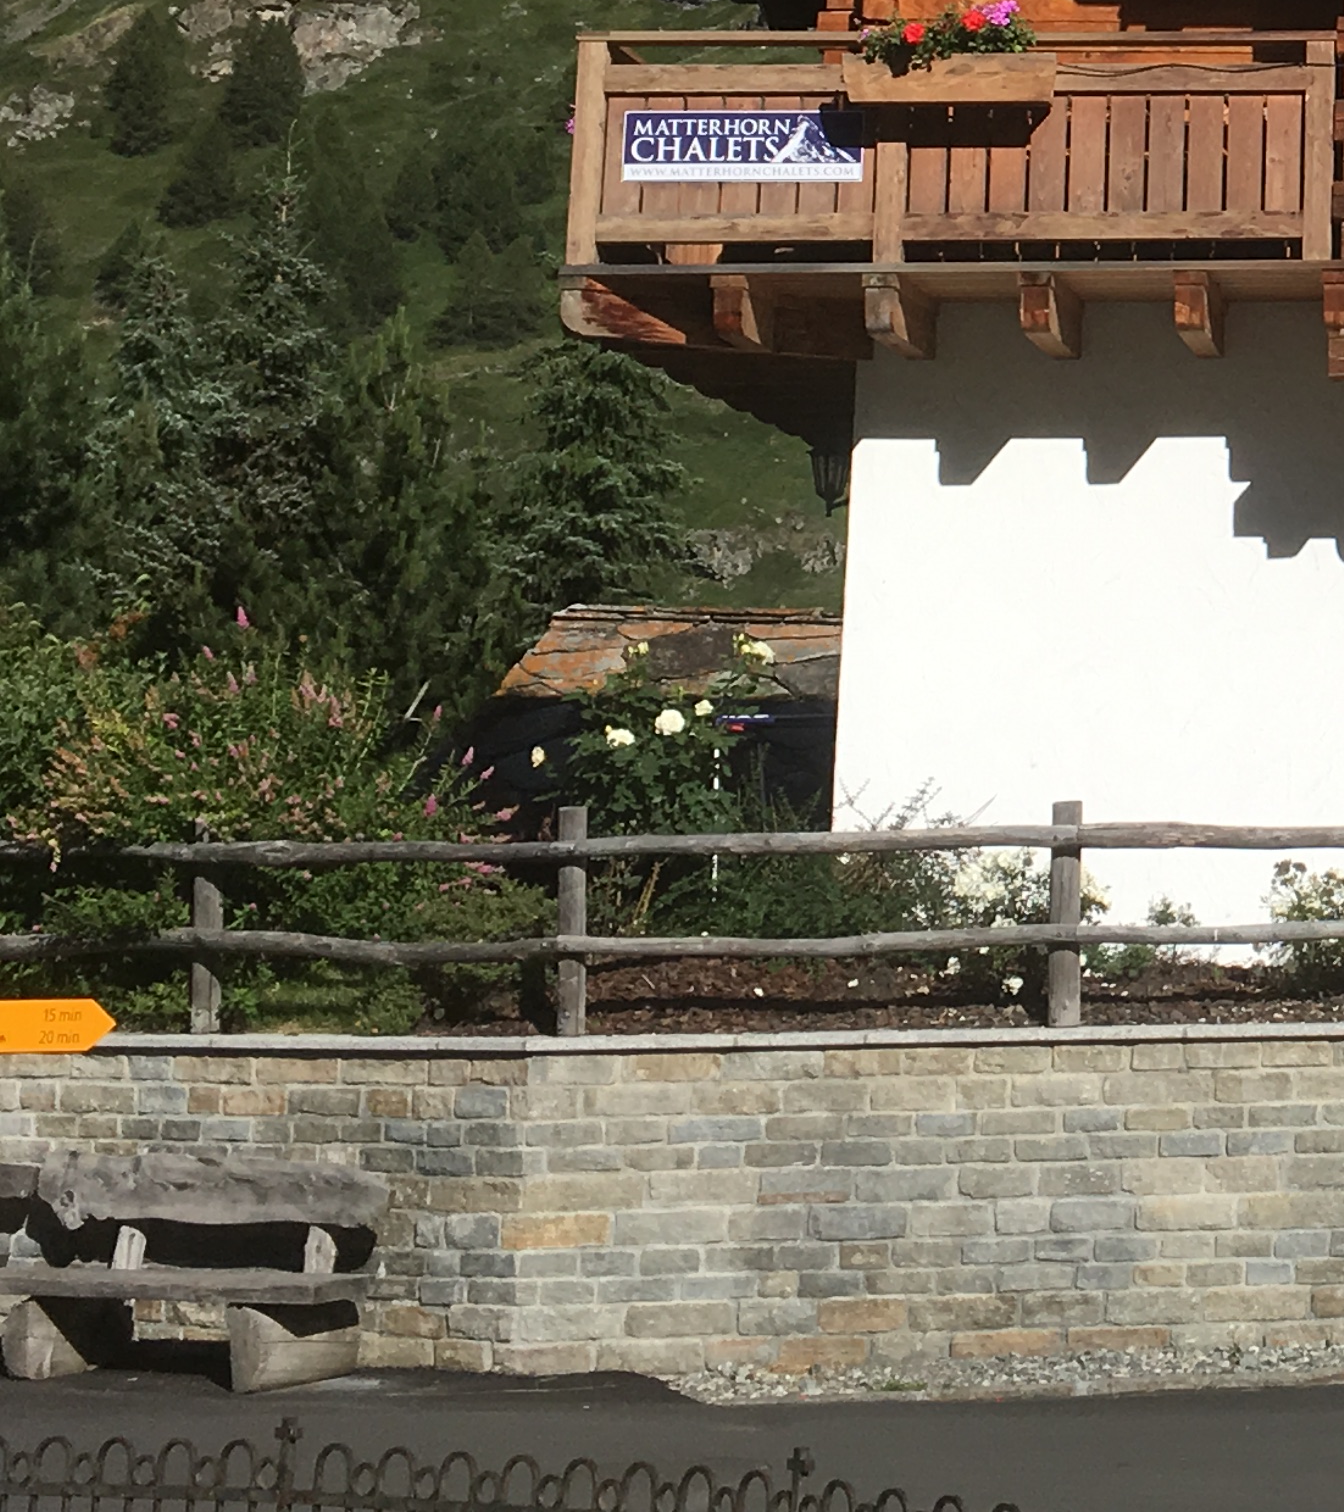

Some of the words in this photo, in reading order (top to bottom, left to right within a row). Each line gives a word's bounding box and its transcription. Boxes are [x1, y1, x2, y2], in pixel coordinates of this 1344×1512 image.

[633, 118, 791, 136] MATTERHORN
[630, 137, 780, 163] CHALETS
[630, 166, 855, 178] WWW.MATTERHORNCHALETS.COM
[43, 1008, 56, 1022] 15
[59, 1008, 82, 1022] min
[39, 1030, 54, 1044] 20
[57, 1030, 80, 1044] min
